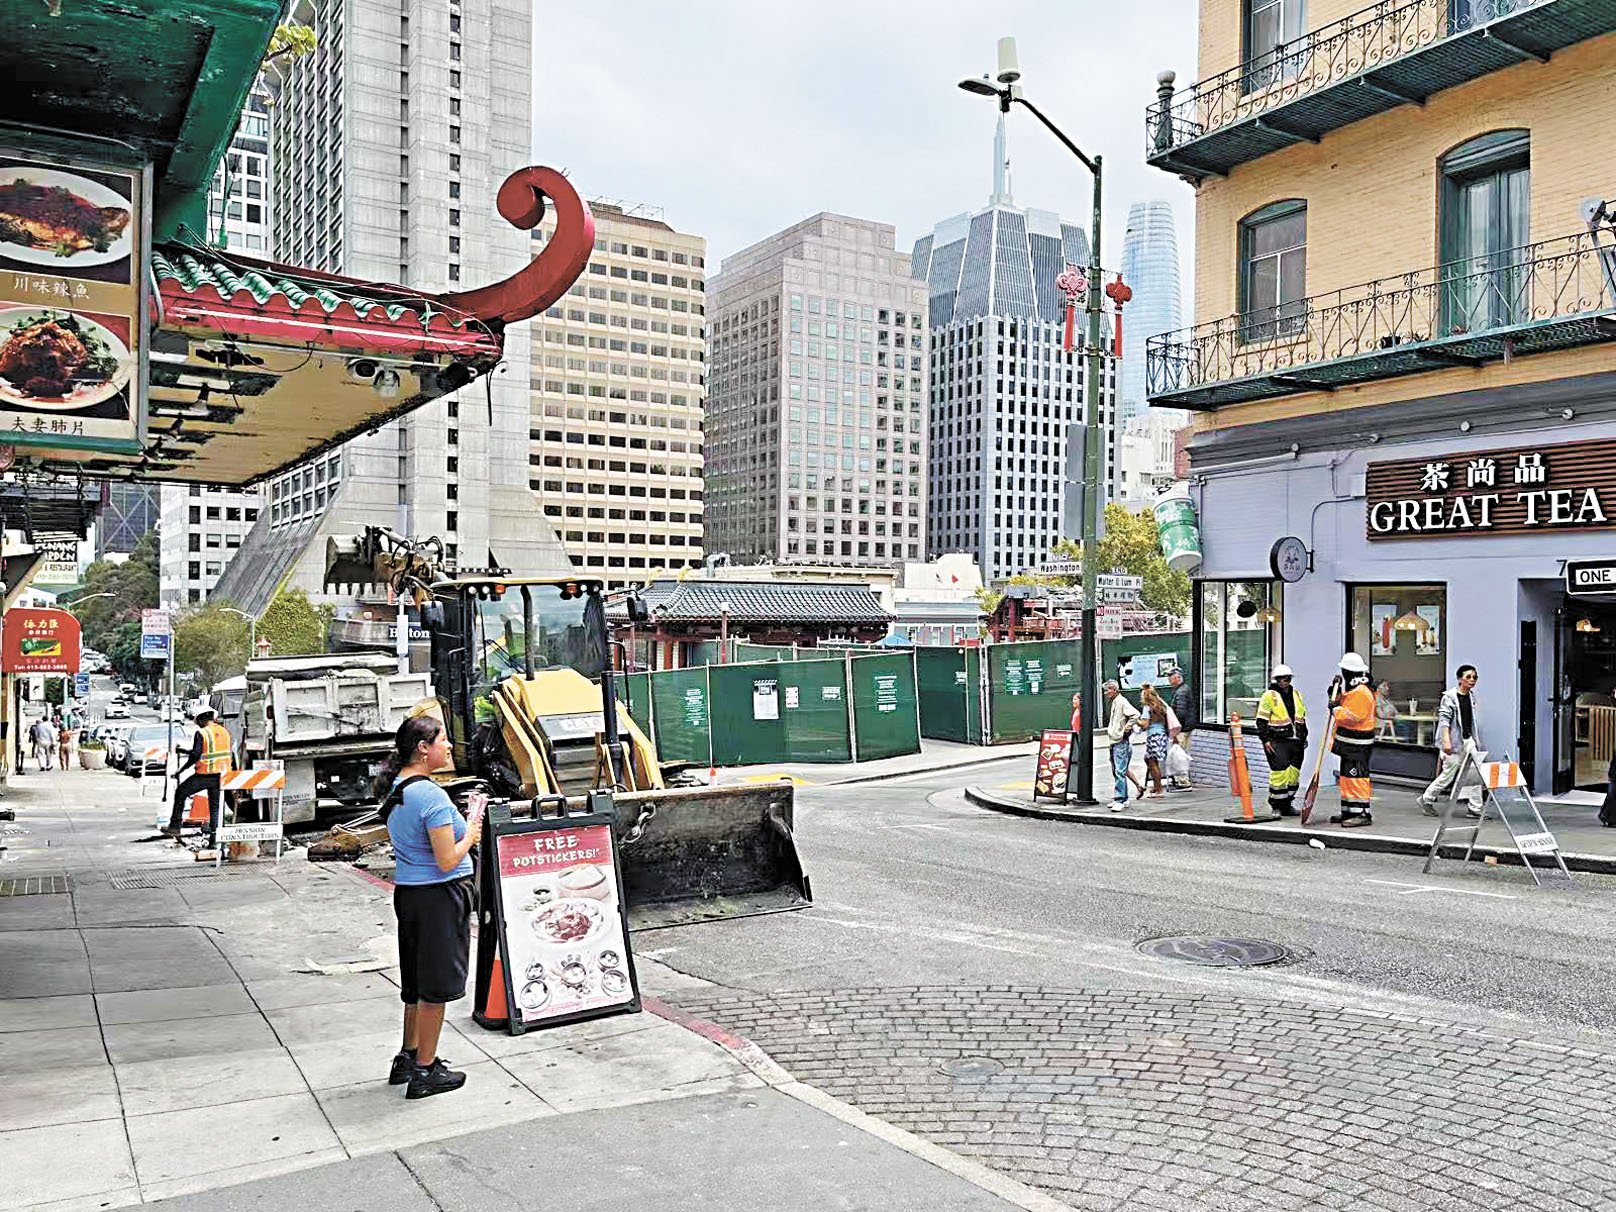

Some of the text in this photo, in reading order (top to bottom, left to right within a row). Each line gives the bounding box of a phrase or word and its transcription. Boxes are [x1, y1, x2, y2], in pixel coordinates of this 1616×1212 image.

[13, 276, 91, 300] 川味辣魚
[12, 416, 85, 437] 夫妻肺片
[1419, 452, 1546, 492] 茶尚品
[1370, 487, 1608, 533] GREAT TEA
[1040, 563, 1080, 573] Washington
[1579, 570, 1611, 583] ONE
[389, 627, 430, 638] Hton
[533, 835, 579, 852] FREE
